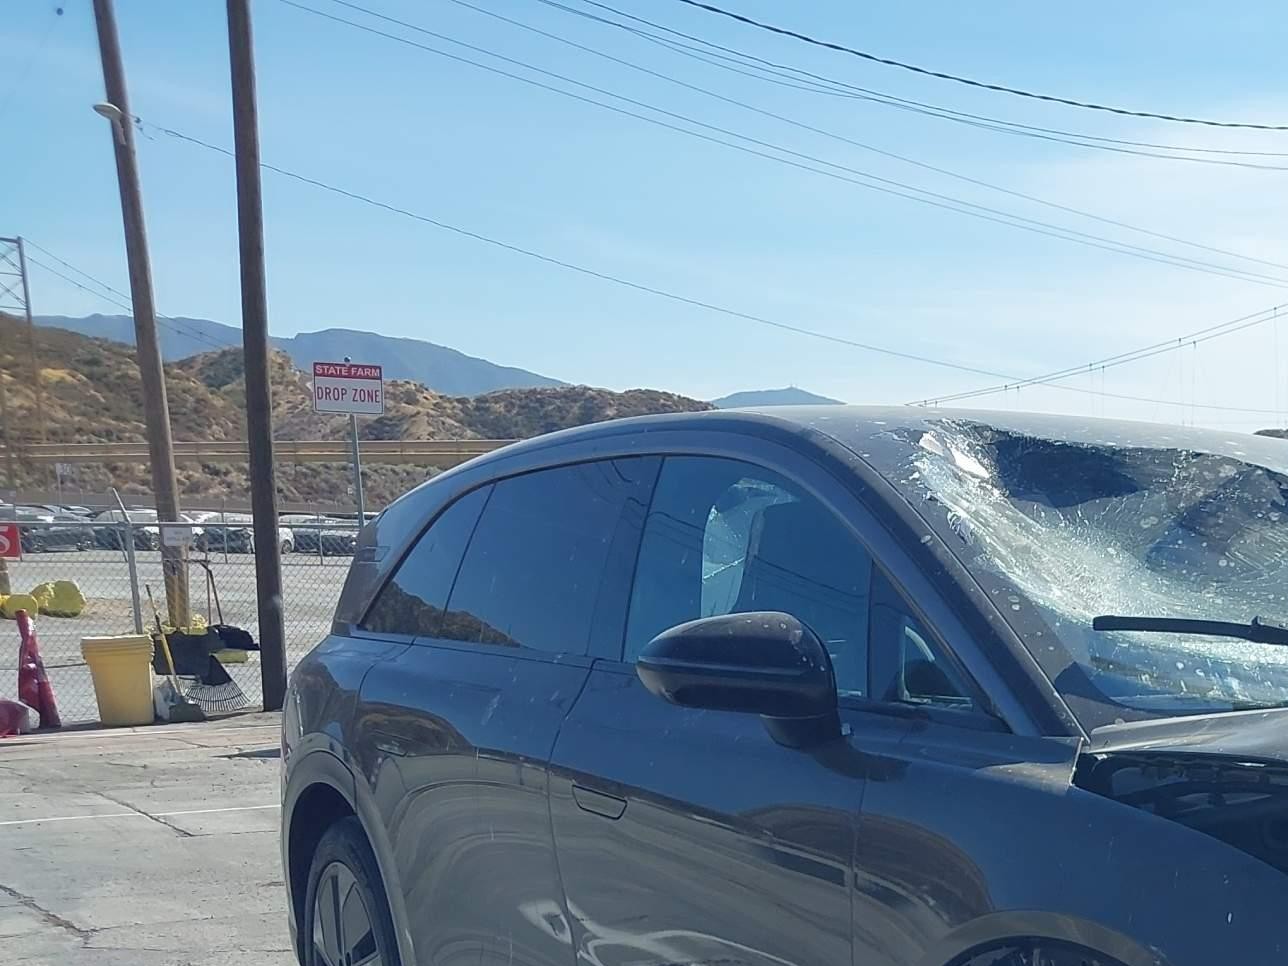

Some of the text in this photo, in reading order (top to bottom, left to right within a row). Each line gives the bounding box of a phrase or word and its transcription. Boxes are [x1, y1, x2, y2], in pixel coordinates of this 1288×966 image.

[315, 364, 380, 377] STATE FARM
[316, 386, 380, 403] DROP ZONE
